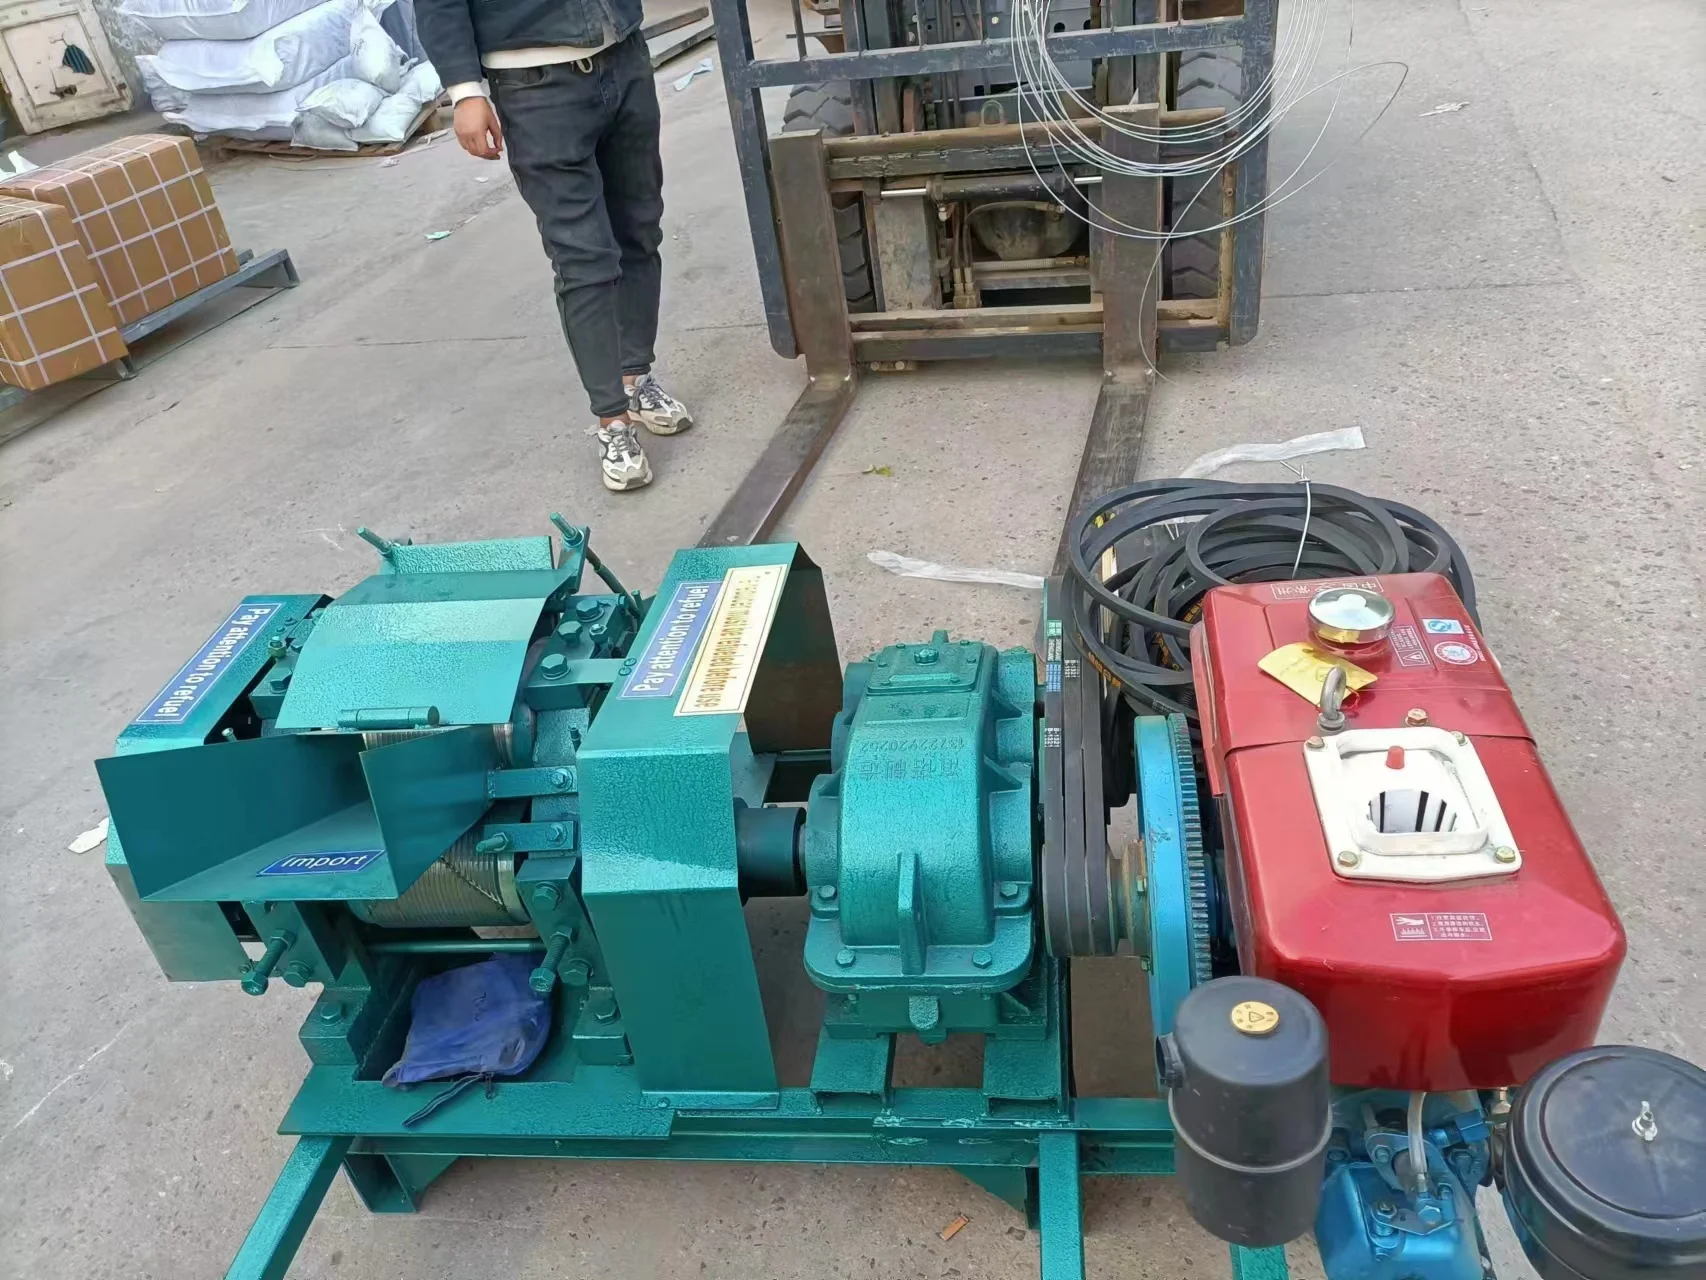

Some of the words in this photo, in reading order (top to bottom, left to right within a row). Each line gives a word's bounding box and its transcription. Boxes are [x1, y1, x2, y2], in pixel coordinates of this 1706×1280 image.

[678, 585, 710, 612] refuel
[231, 608, 272, 626] Pay
[676, 612, 697, 623] to
[722, 608, 749, 627] must
[195, 627, 251, 671] attention
[647, 620, 692, 670] attention
[708, 636, 749, 666] refueled
[184, 672, 214, 684] to
[631, 669, 675, 692] Pay
[699, 666, 740, 692] before
[153, 685, 198, 717] refuel
[693, 692, 722, 708] use
